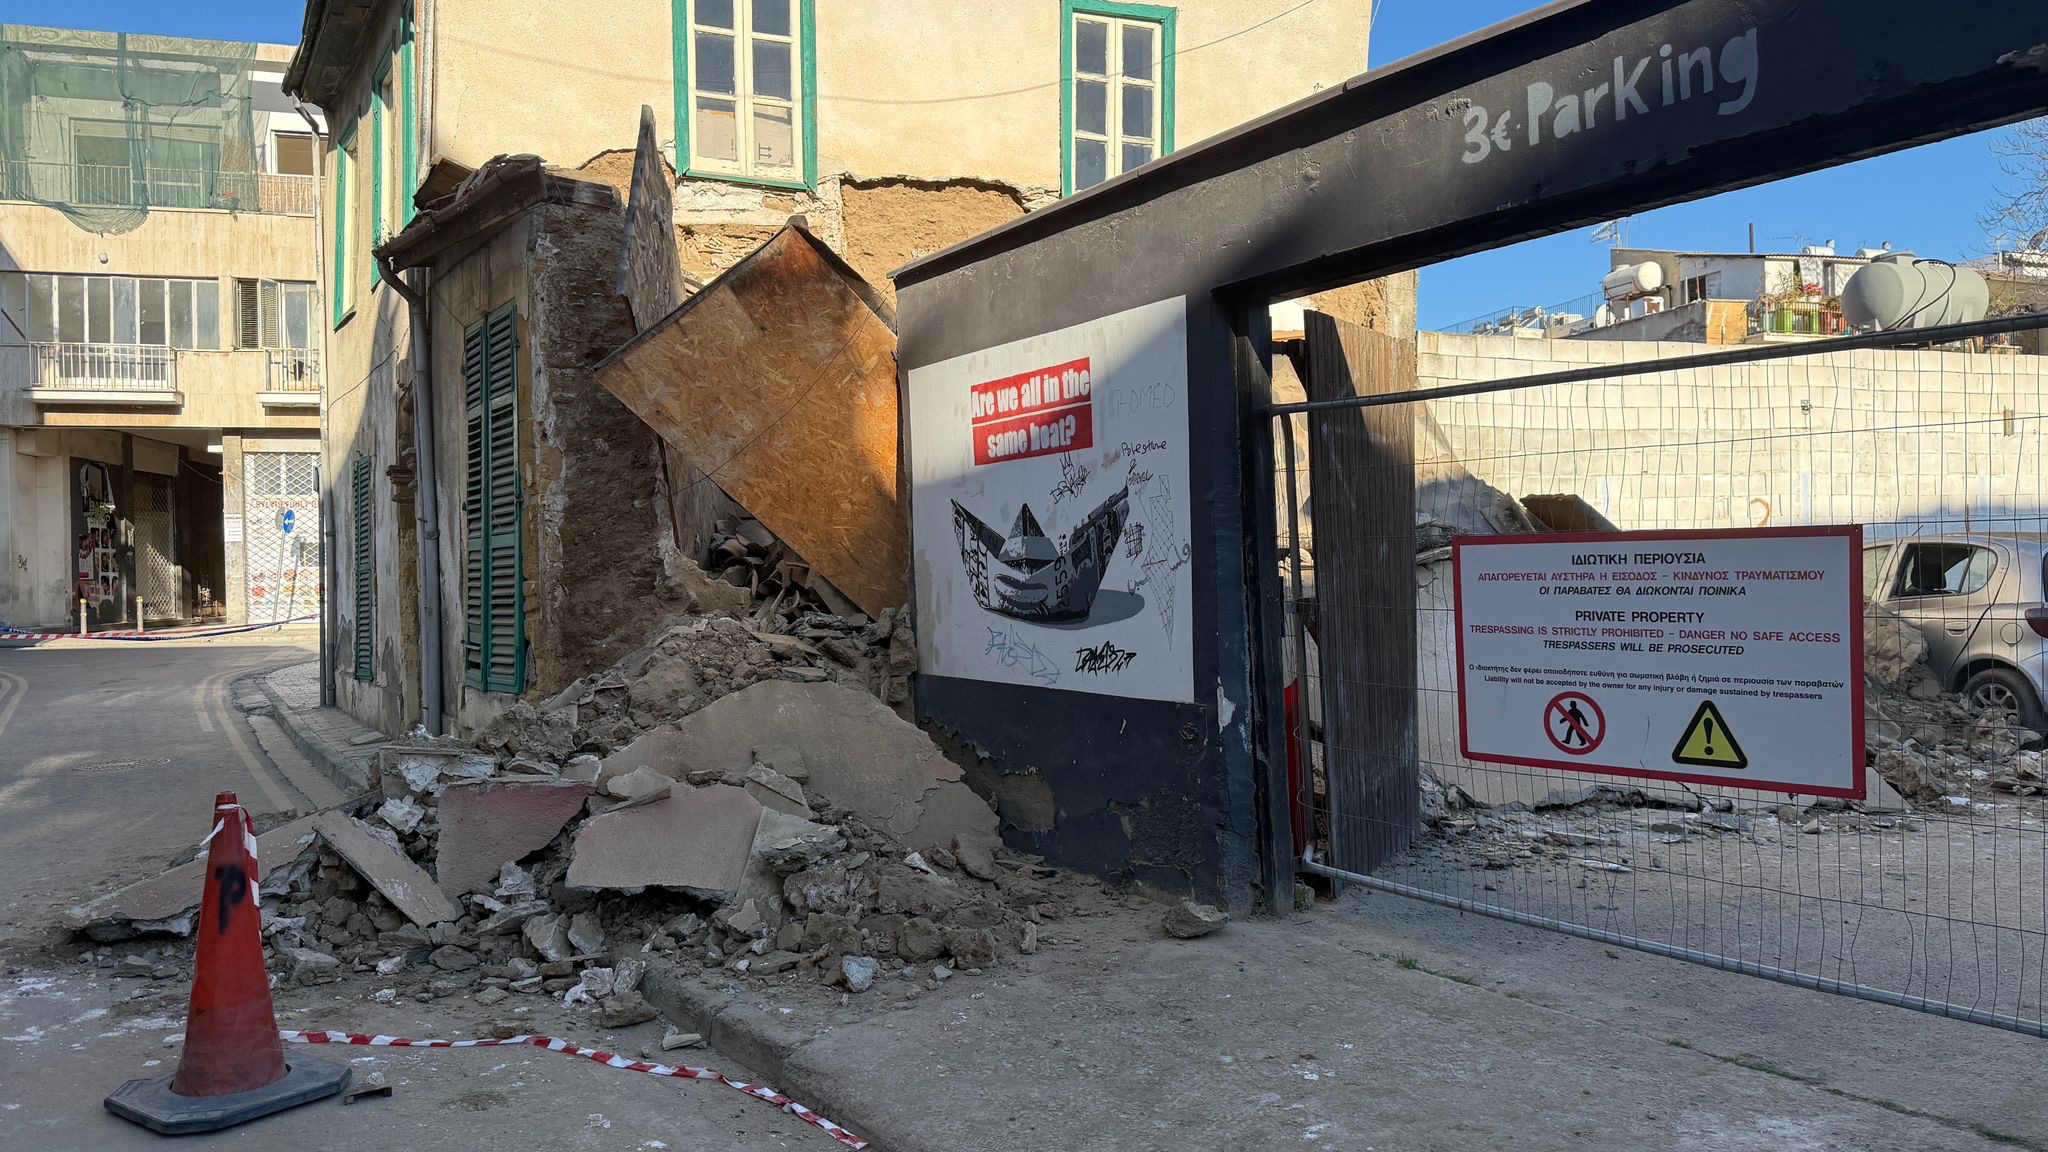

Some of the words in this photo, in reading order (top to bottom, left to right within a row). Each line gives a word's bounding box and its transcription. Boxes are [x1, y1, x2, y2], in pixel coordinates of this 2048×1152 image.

[971, 391, 994, 418] Are
[997, 386, 1018, 412] we
[1021, 374, 1041, 408] all
[1043, 373, 1060, 404] in
[1062, 368, 1090, 398] the
[987, 429, 1027, 458] same
[1030, 415, 1076, 450] boat?
[1572, 554, 1627, 565] ΙΔΙΩΤΙΚΗ
[1634, 553, 1706, 565] ΠΕΡΙΟΥΣΙΑ
[1478, 572, 1546, 581] ΑΠΑΓΟΡΕΥΕΤΑΙ
[1551, 572, 1595, 581] ΑΥΣΤΗΡΑ
[1612, 571, 1657, 581] ΕΙΣΟΔΟΣ
[1673, 571, 1729, 581] ΚΙΝΔΥΝΟΣ
[1735, 570, 1825, 580] ΤΡΑΥΜΑΤΙΣΜΟΥ
[1539, 587, 1549, 595] ΟΙ
[1554, 586, 1612, 595] ΠΑΡΑΒΑΤΕΣ
[1616, 586, 1631, 595] ΘΑ
[1635, 586, 1694, 595] ΔΙΩΚΟΝΤΑΙ
[1699, 587, 1746, 596] ΠΟΙΝΙΚΑ
[1575, 611, 1626, 622] PRIVATE
[1631, 612, 1705, 623] PROPERTY
[1470, 625, 1534, 635] TRESPASSING
[1538, 626, 1547, 635] IS
[1551, 627, 1597, 636] STRICTLY
[1602, 628, 1664, 638] PROHIBITED
[1679, 630, 1725, 640] DANGER
[1730, 631, 1748, 640] NO
[1753, 631, 1783, 641] SAFE
[1788, 632, 1841, 642] ACCESS
[1543, 640, 1616, 651] TRESPASSERS
[1620, 642, 1645, 652] WILL
[1649, 643, 1663, 653] BE
[1667, 643, 1745, 655] PROSECUTED
[1476, 664, 1508, 673] ιδιοκτήτης
[1589, 670, 1615, 679] ευθύνη
[1629, 672, 1664, 680] σωματική
[1666, 673, 1689, 682] βλάβη
[1698, 674, 1719, 683] ζημιά
[1733, 677, 1774, 686] περιουσία
[1794, 680, 1844, 688] παραβατών
[1484, 675, 1509, 684] Liability
[1546, 679, 1577, 687] accepted
[1579, 680, 1587, 688] by
[1626, 682, 1636, 690] for
[1638, 684, 1651, 692] any
[1653, 684, 1674, 693] injury
[1686, 686, 1717, 695] damage
[1719, 688, 1758, 696] sustained
[1760, 690, 1771, 698] by
[1773, 691, 1823, 700] trespassers
